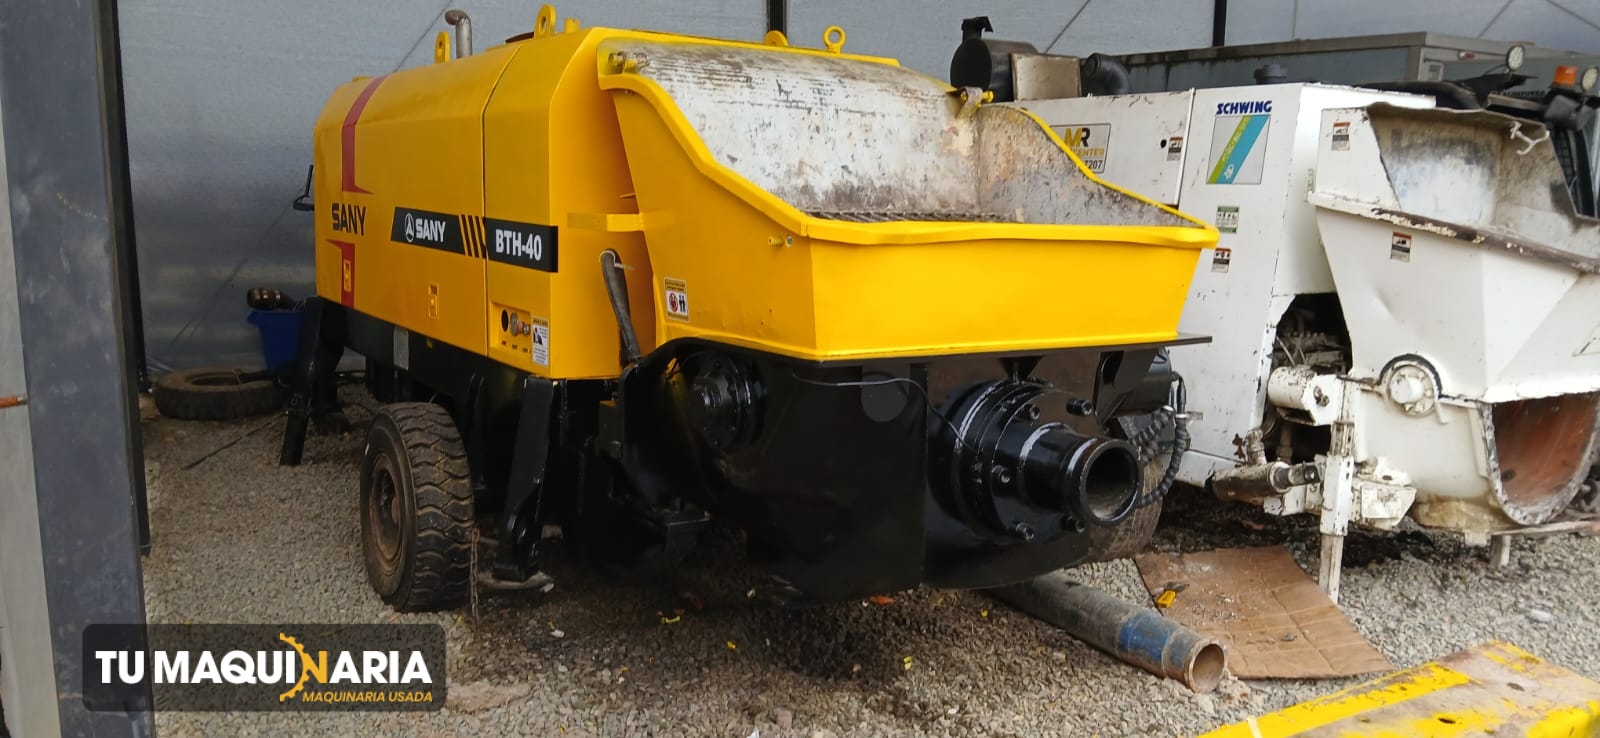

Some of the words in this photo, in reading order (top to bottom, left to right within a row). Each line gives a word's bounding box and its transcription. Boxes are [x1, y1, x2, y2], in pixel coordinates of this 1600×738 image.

[1216, 101, 1272, 115] SCHWING
[1064, 127, 1090, 147] MR
[332, 203, 366, 236] SANY
[415, 218, 446, 242] SANY
[495, 229, 542, 261] BTH-40
